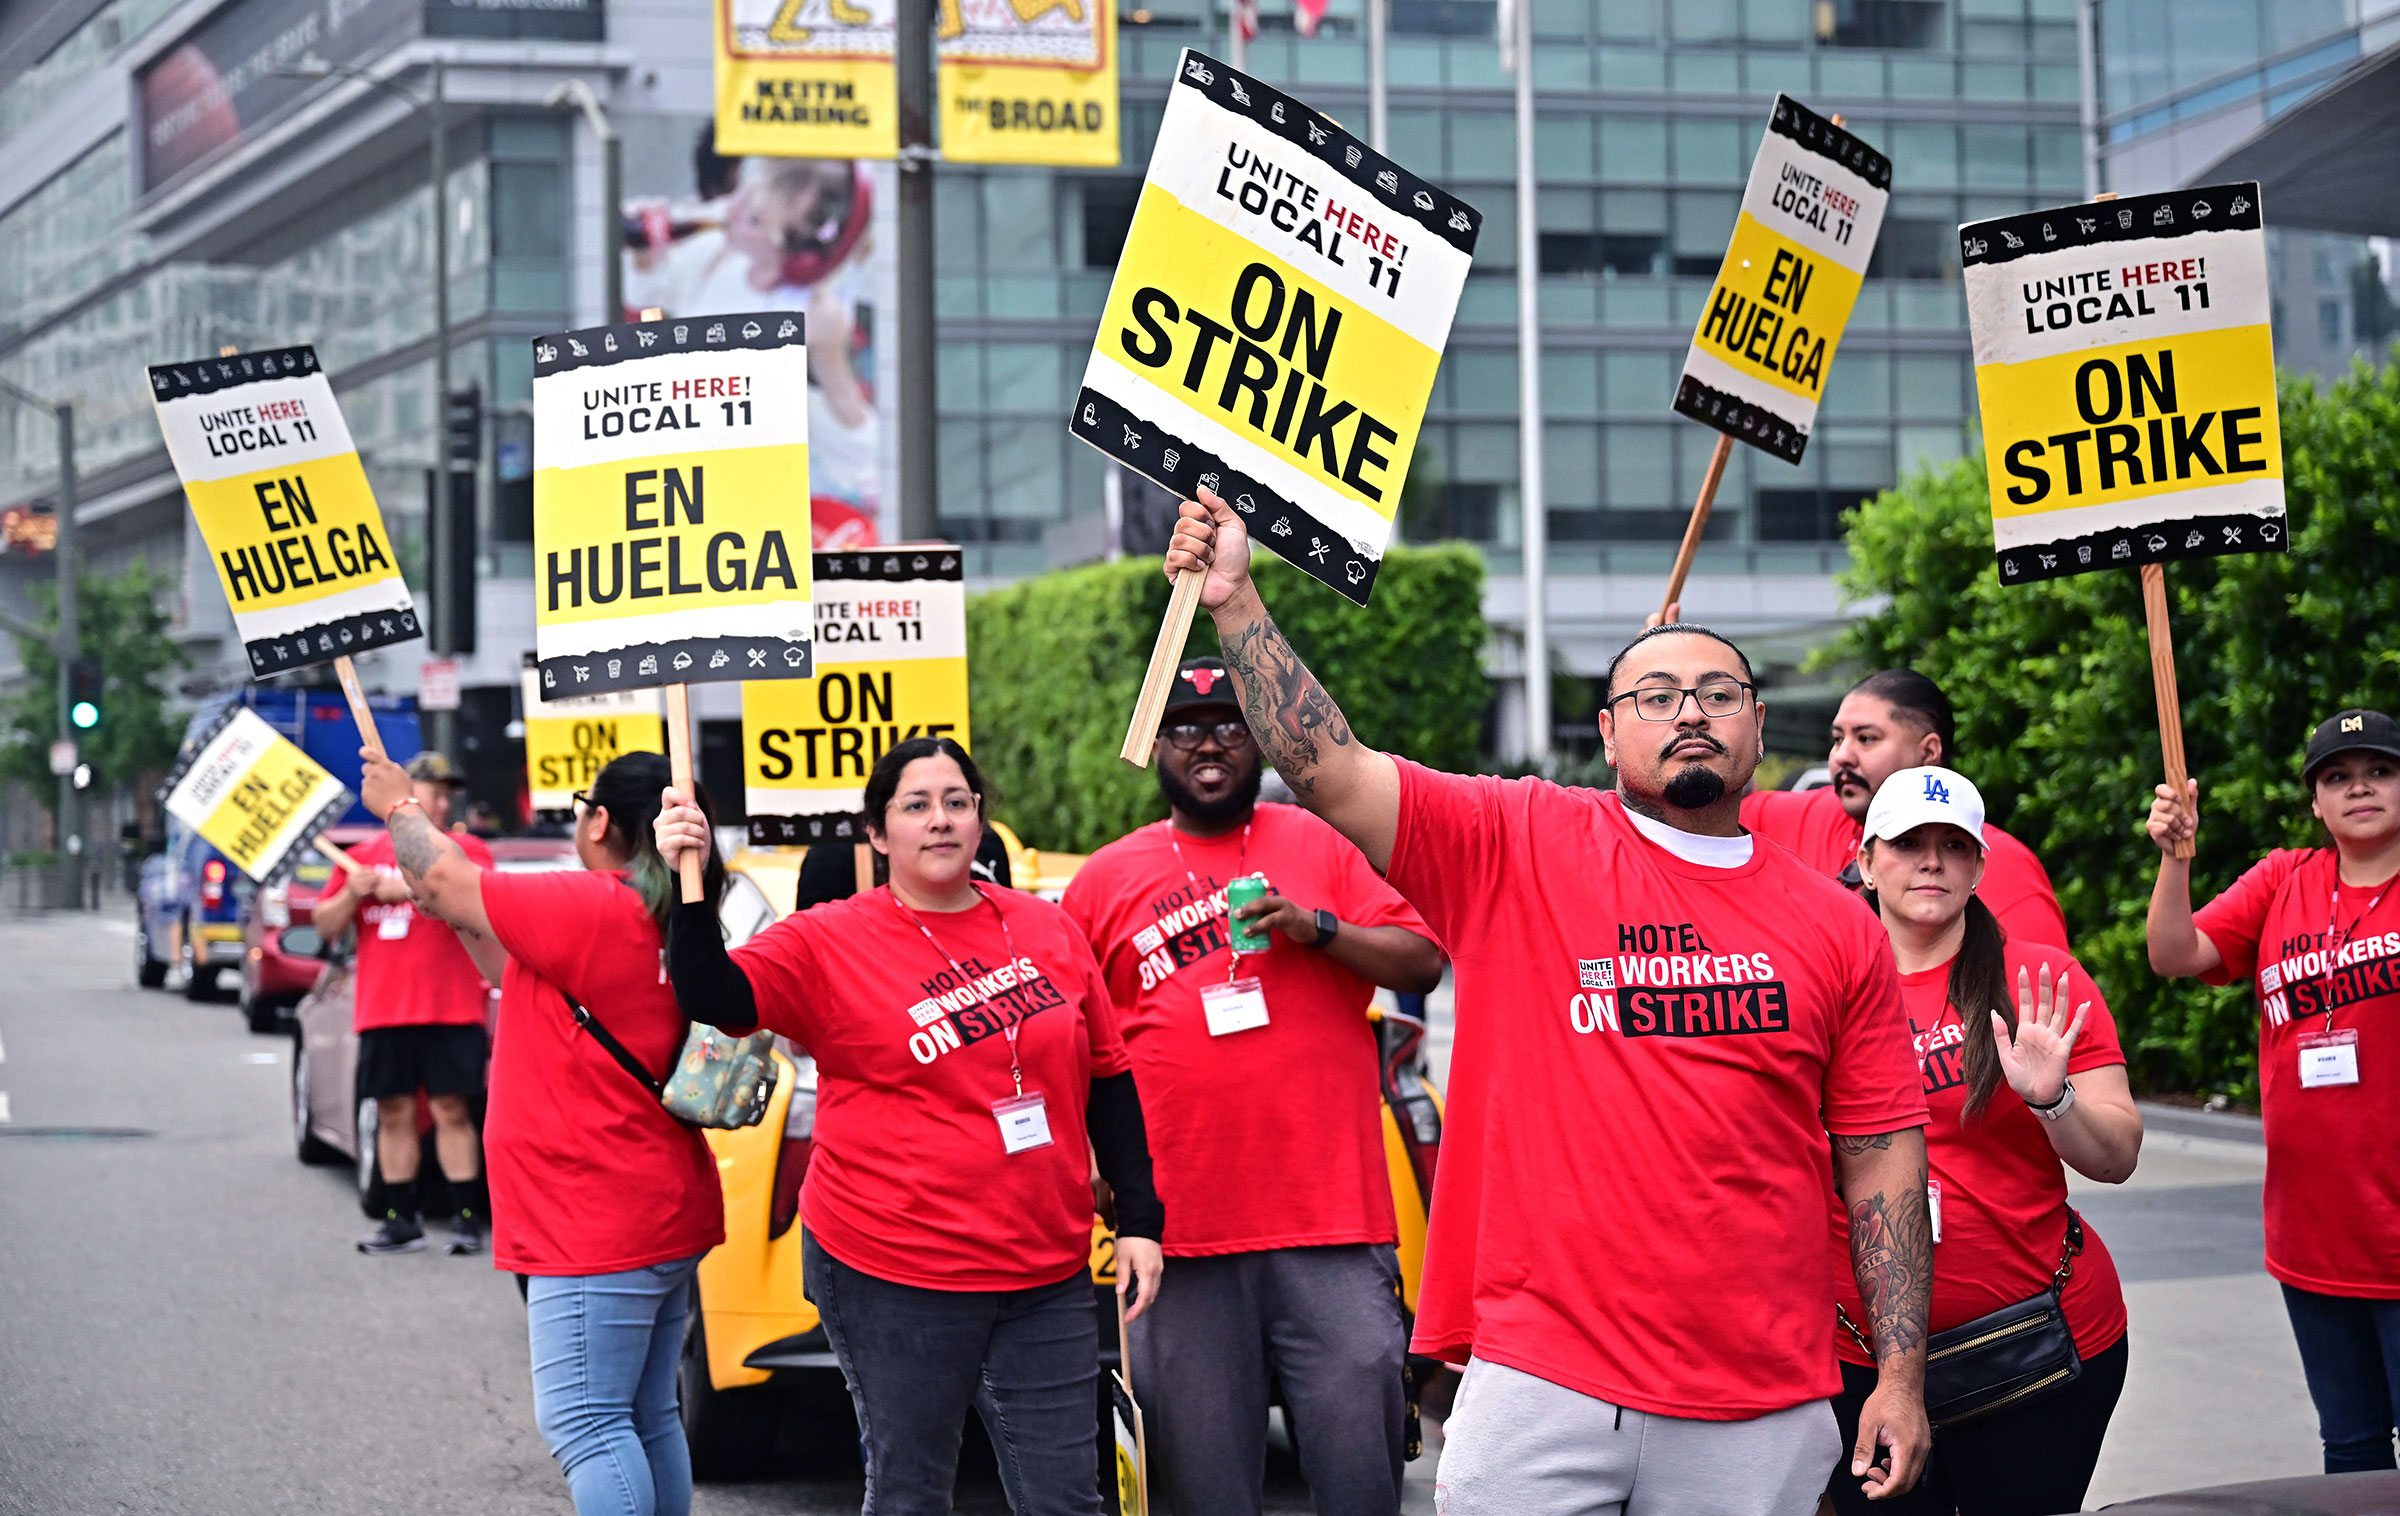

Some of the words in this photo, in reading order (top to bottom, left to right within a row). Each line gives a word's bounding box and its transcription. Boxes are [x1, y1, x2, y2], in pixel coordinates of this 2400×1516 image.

[757, 80, 854, 100] KEITH
[990, 99, 1103, 132] BROAD
[1228, 142, 1319, 211] UNITE
[1324, 198, 1409, 267] HERE!
[1771, 183, 1826, 233] LOCAL
[1835, 218, 1853, 246] 11
[1781, 162, 1822, 198] UNITE
[1822, 186, 1860, 220] HERE!
[1216, 166, 1344, 267] LOCAL
[1368, 257, 1402, 300] 11
[1763, 248, 1814, 315] EN
[2023, 270, 2112, 303] UNITE
[2121, 257, 2206, 288] HERE!
[1231, 262, 1343, 382] ON
[2025, 289, 2156, 334] LOCAL
[2174, 282, 2210, 311] 11
[1703, 286, 1826, 391] HUELGA
[583, 382, 662, 411] UNITE
[672, 375, 751, 400] HERE!
[1121, 286, 1398, 503] STRIKE
[2075, 349, 2178, 425] ON
[200, 407, 256, 432] UNITE
[257, 399, 307, 423] HERE!
[207, 424, 287, 457] LOCAL
[293, 420, 318, 442] 11
[584, 403, 701, 441] LOCAL
[720, 400, 752, 427] 11
[2004, 406, 2267, 506] STRIKE
[254, 475, 318, 532] EN
[625, 465, 704, 531] EN
[221, 523, 390, 601] HUELGA
[547, 529, 798, 612] HUELGA
[814, 601, 850, 619] ITE
[857, 600, 921, 618] HERE!
[814, 621, 881, 643] CAL
[897, 620, 923, 642] 11
[818, 671, 893, 724] ON
[573, 721, 617, 752] ON
[759, 724, 955, 780] STRI
[229, 767, 319, 862] HUELGA
[231, 773, 270, 815] EN
[1923, 774, 1950, 804] LA
[1138, 947, 1175, 991] ON
[1580, 961, 1612, 971] UNITE
[1581, 970, 1612, 980] HERE!
[1582, 979, 1604, 987] LOCAL
[1618, 952, 1774, 986] WORKERS
[908, 1019, 961, 1064] ON
[959, 979, 1062, 1039] STRIKE
[1569, 993, 1620, 1034] ON
[1630, 987, 1783, 1033] STRIKE
